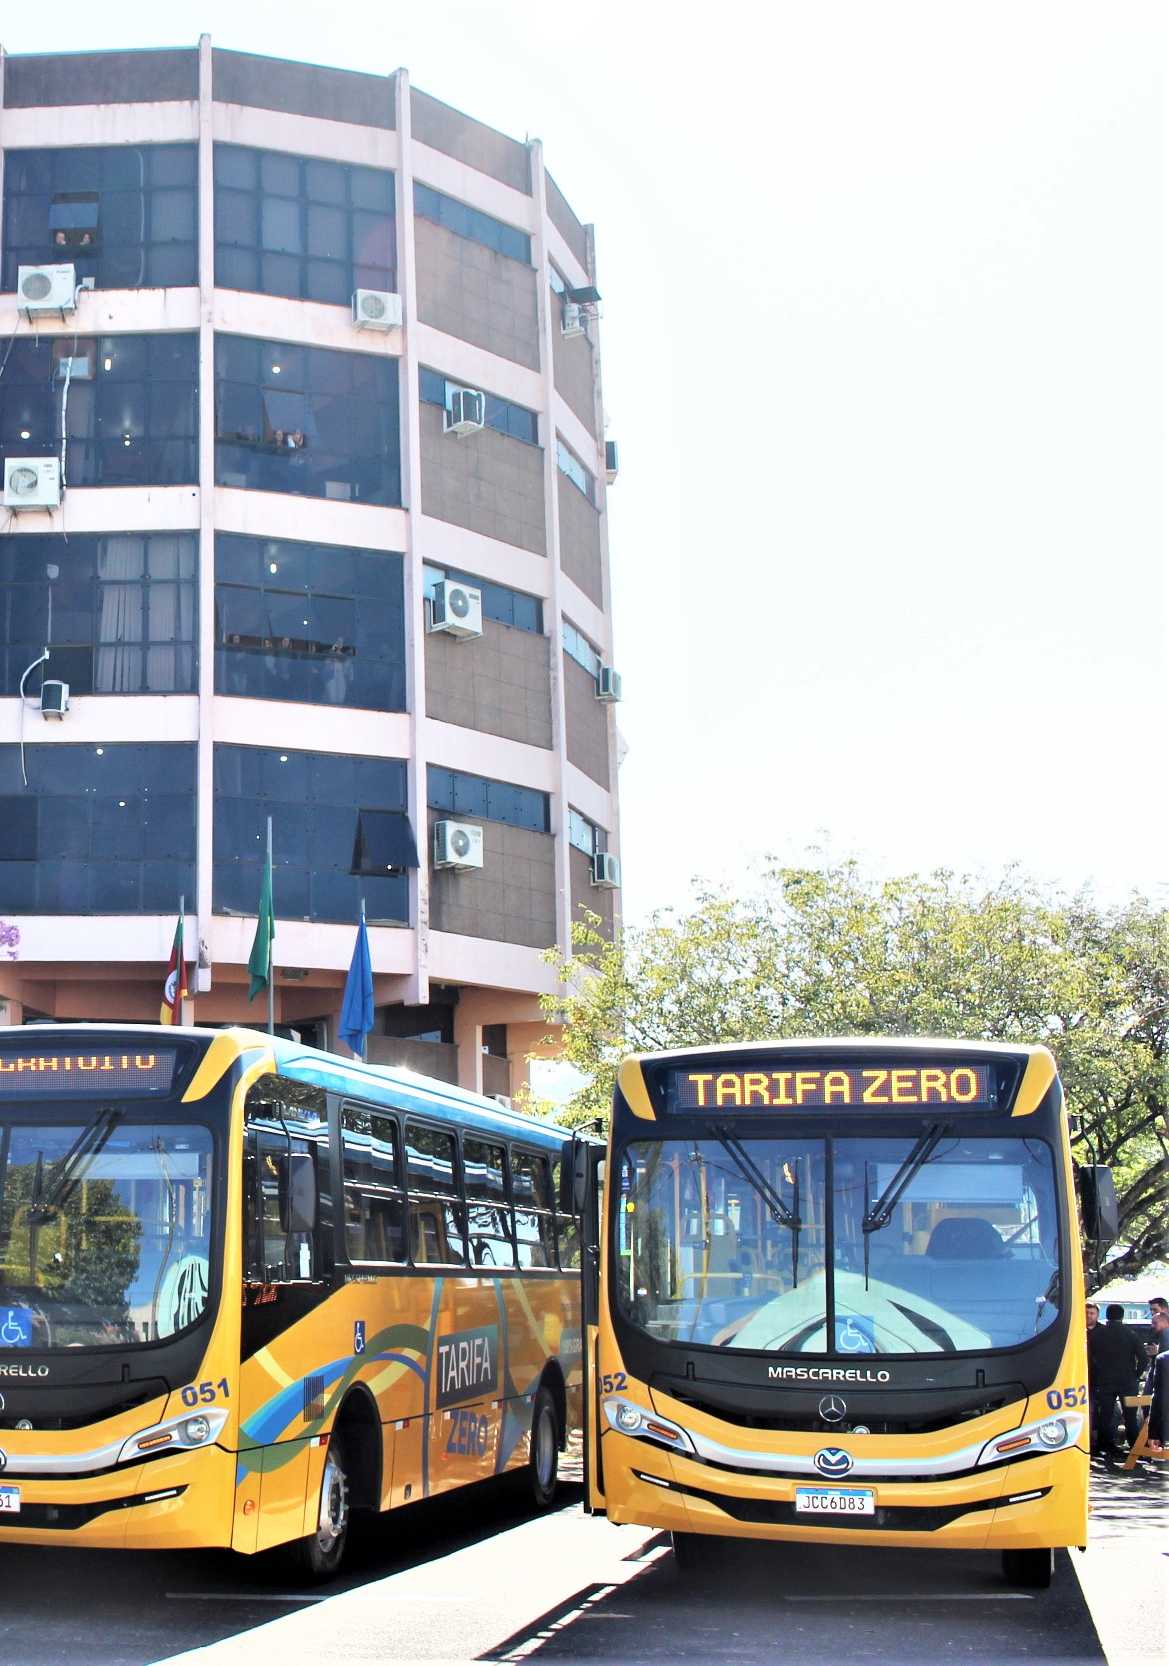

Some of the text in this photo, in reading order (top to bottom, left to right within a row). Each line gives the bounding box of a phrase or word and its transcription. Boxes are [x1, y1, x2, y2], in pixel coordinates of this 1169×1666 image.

[688, 1068, 978, 1106] TARIFA ZERO
[439, 1337, 491, 1393] TARIFA
[768, 1366, 890, 1382] MASCARELLO
[182, 1378, 231, 1407] 051
[1046, 1384, 1087, 1410] 052
[446, 1409, 488, 1456] ZERO
[803, 1496, 865, 1511] JCC6D83
